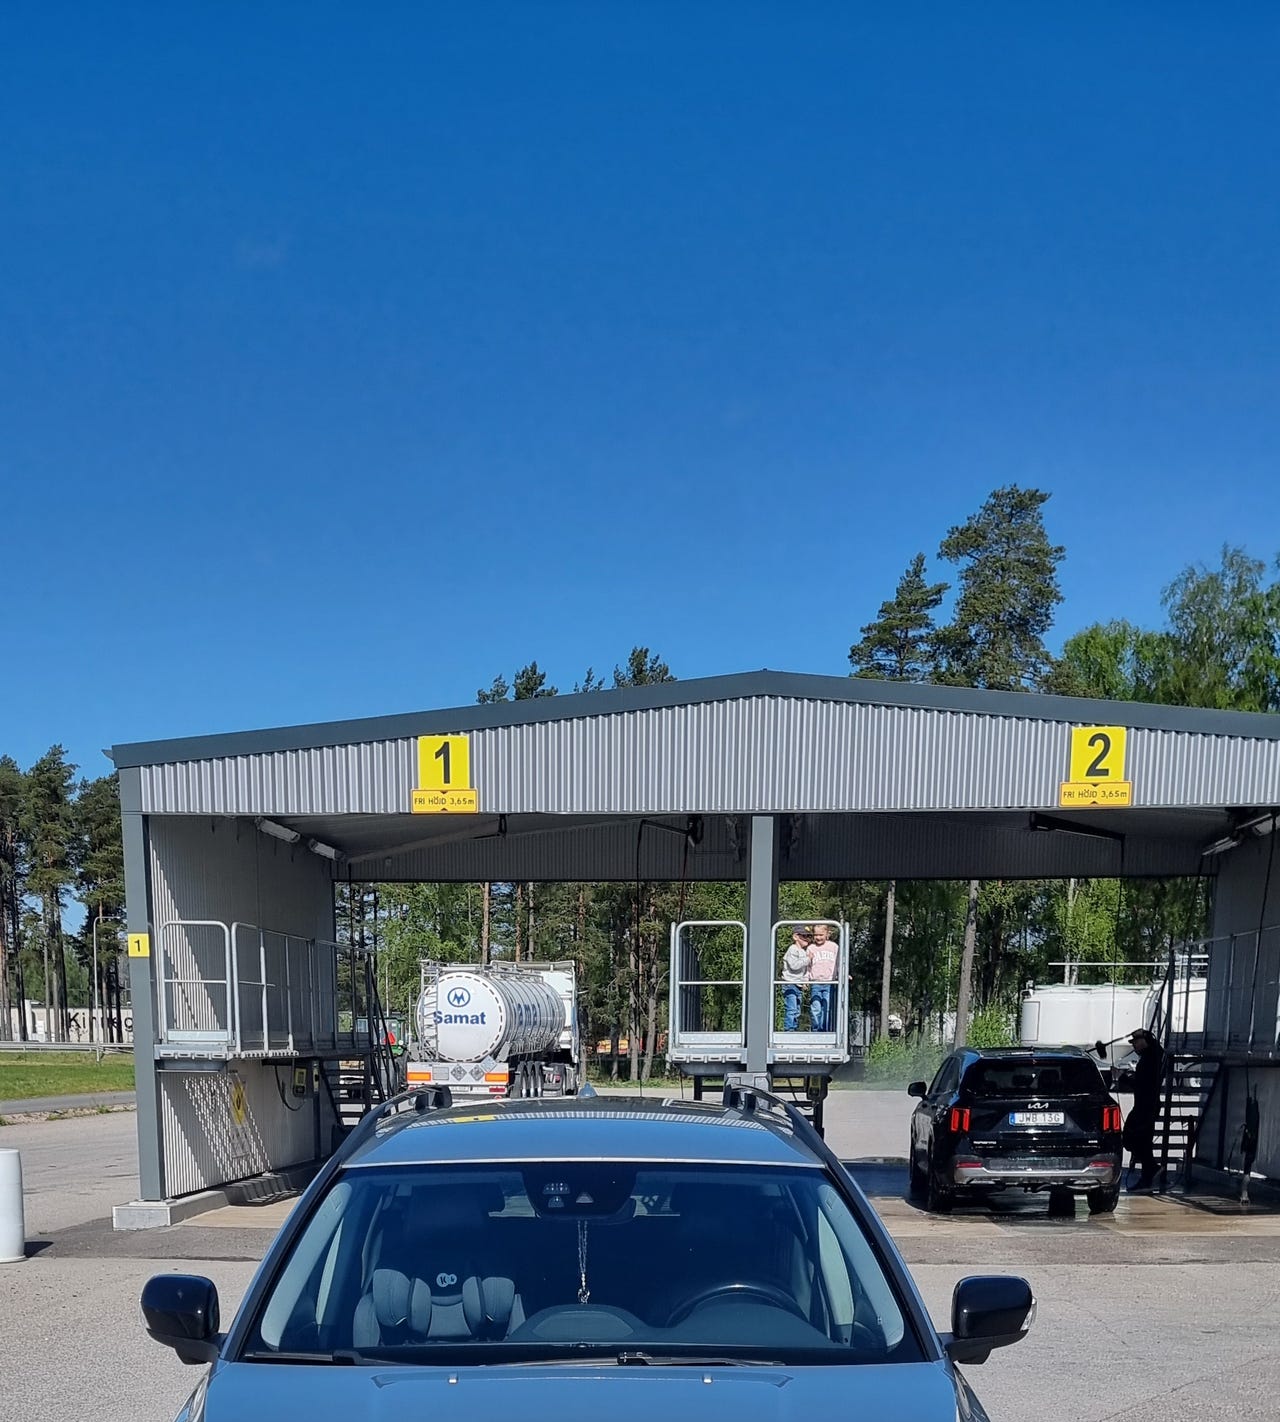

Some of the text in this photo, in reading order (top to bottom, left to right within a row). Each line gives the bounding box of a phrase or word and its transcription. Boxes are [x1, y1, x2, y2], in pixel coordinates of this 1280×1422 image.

[1085, 733, 1111, 777] 2
[435, 741, 450, 784] 1
[1063, 791, 1074, 799] FRI
[1078, 789, 1097, 798] HÖJD
[414, 797, 425, 805] FRI
[133, 939, 141, 952] 1
[433, 1010, 486, 1025] Samat
[1019, 1113, 1037, 1122] JWB
